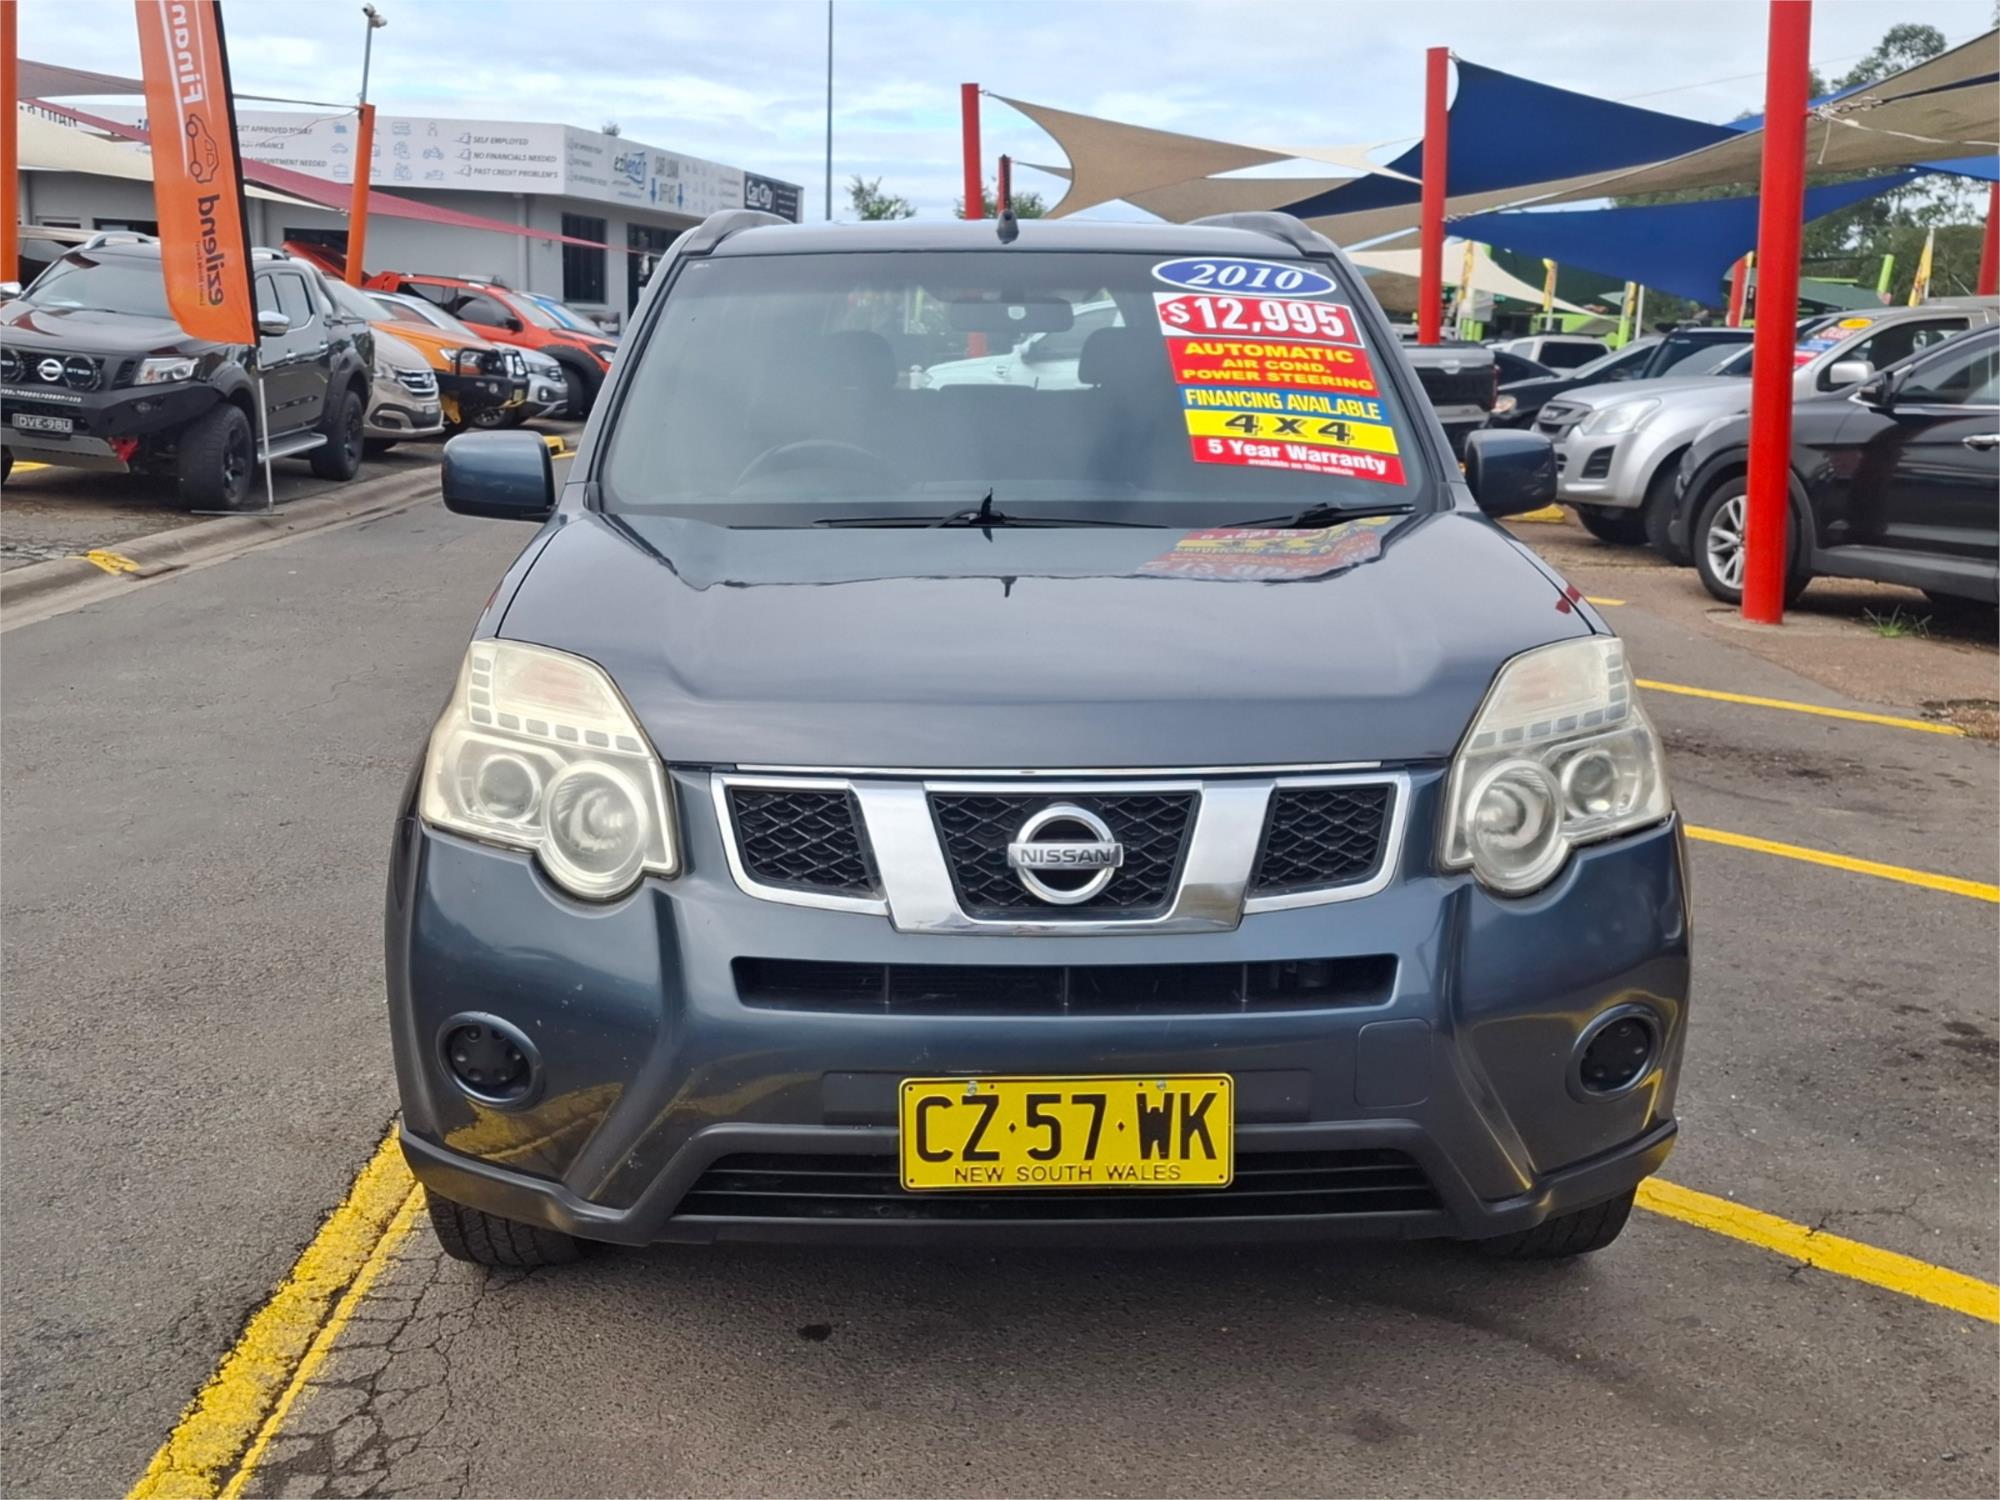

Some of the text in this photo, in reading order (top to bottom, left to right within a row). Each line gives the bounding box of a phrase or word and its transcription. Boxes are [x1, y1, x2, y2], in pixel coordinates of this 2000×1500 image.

[490, 137, 529, 145] EMPLOYED
[473, 152, 485, 160] NO
[1186, 263, 1305, 291] 2010
[1165, 297, 1345, 337] $12,995
[1185, 342, 1355, 364] AUTOMATIC
[1222, 358, 1332, 374] AIR COND.
[1182, 368, 1375, 391] POWER STEERING
[1185, 389, 1382, 420] FINANCING AVAILABLE
[1225, 413, 1261, 435] 4
[1318, 421, 1353, 445] 4
[1208, 438, 1386, 475] 5 Year Warranty
[1020, 849, 1111, 864] NISSAN
[954, 1164, 1182, 1183] NEW SOUTH WALES
